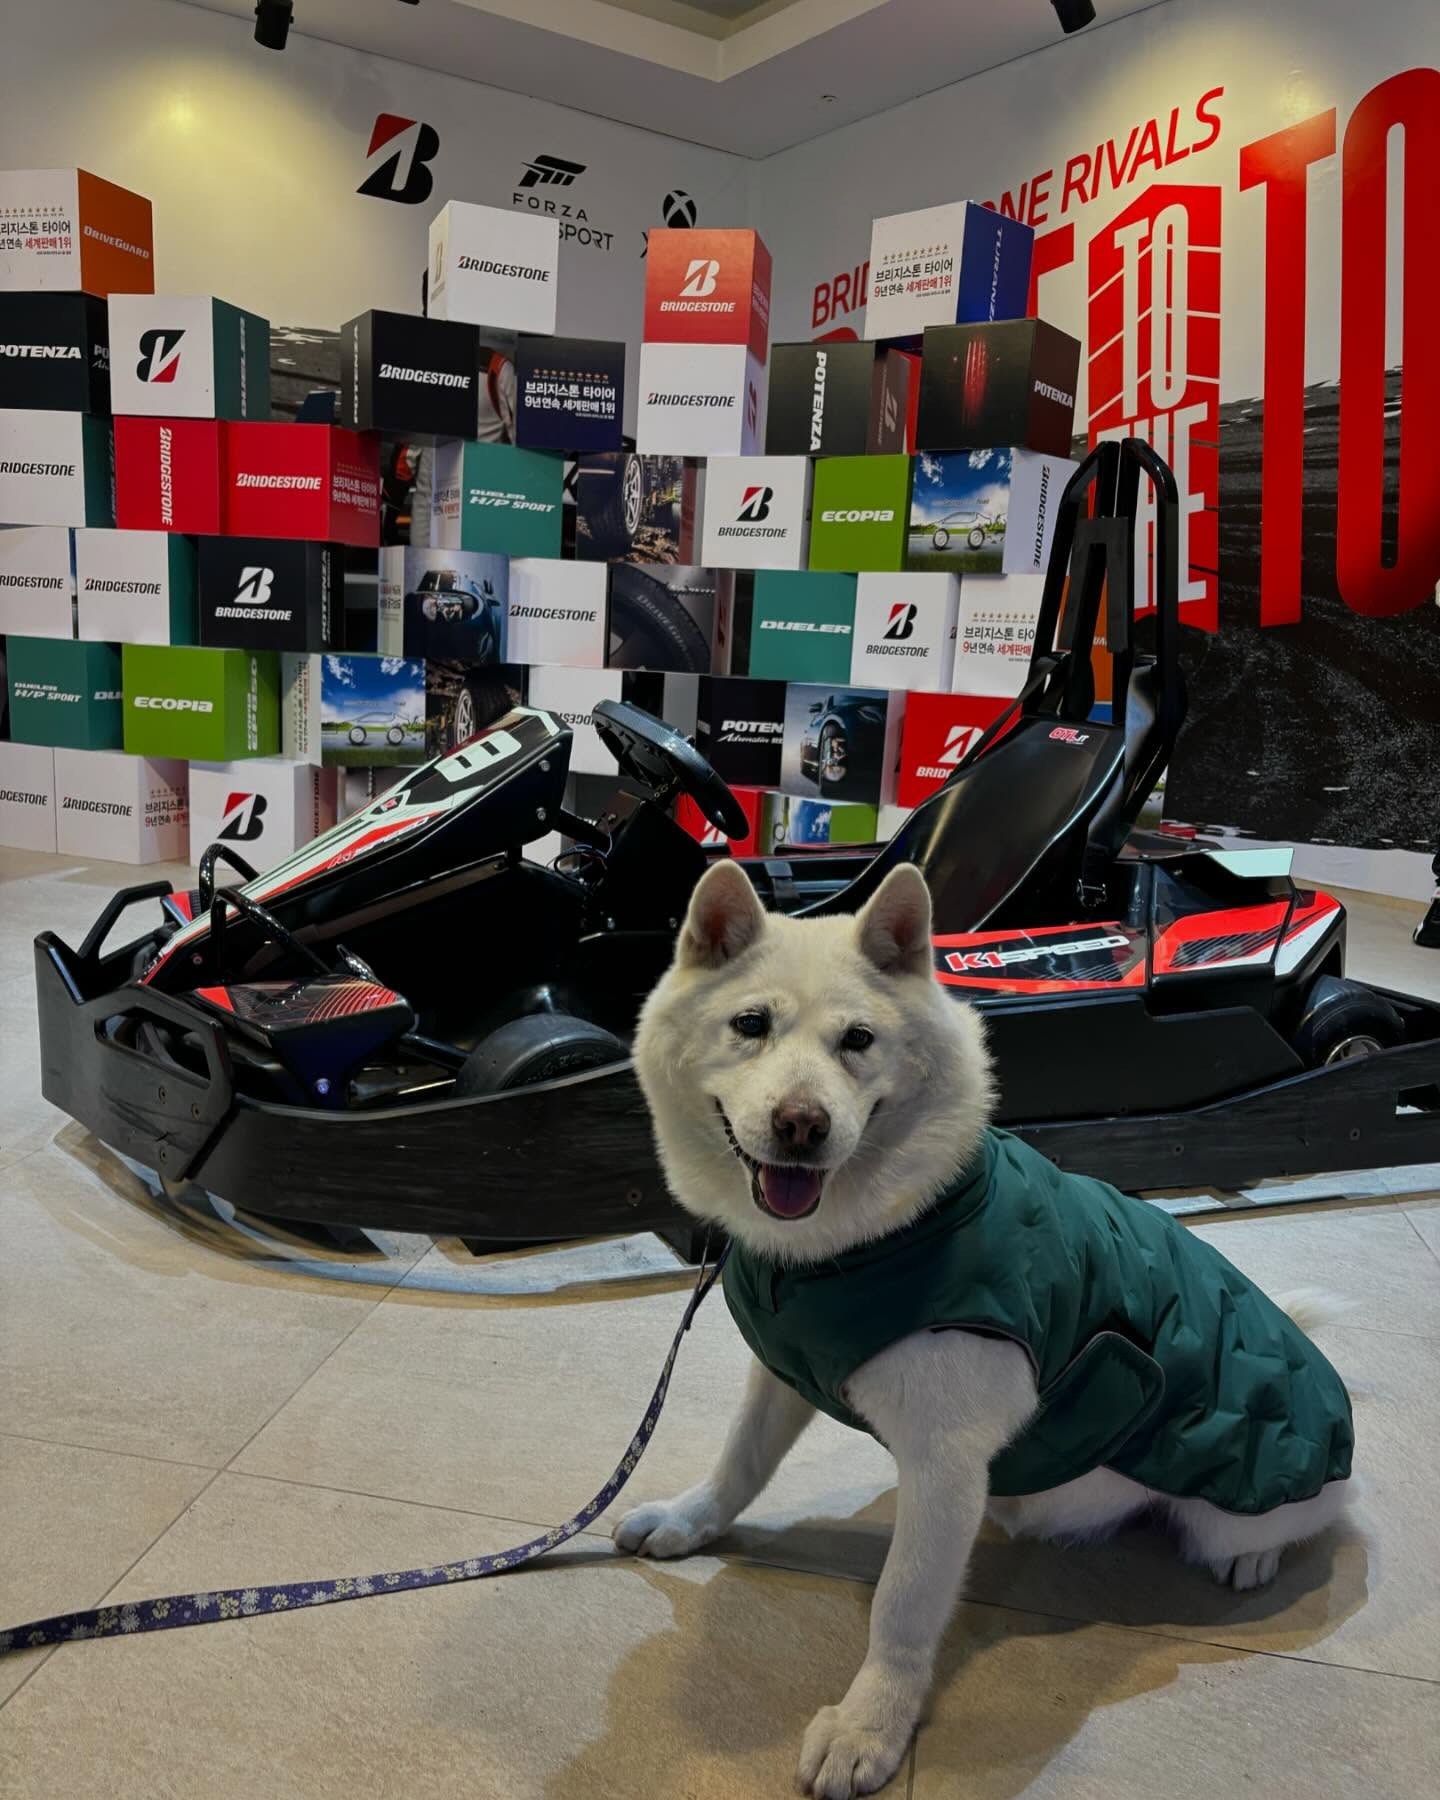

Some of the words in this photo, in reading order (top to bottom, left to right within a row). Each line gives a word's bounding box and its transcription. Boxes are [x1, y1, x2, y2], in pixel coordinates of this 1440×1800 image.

[1061, 87, 1224, 213] RIVALS
[513, 193, 588, 221] FORZA
[0, 221, 39, 236] 리지스톤
[42, 220, 70, 235] 타이어
[458, 256, 550, 282] BRIDGESTONE
[875, 263, 921, 283] 브리지스톤
[924, 257, 953, 275] 타이어
[660, 301, 736, 313] BRIDGESTONE
[1114, 203, 1188, 419] TO
[379, 363, 471, 389] BRIDGESTONE
[525, 381, 580, 398] 브리지스톤
[583, 385, 615, 401] 타이어
[647, 392, 736, 407] BRIDGESTONE
[1033, 380, 1073, 408] POTENZA
[810, 351, 827, 451] POTENZA
[160, 426, 173, 526] BRIDGESTONE
[236, 472, 322, 490] BRIDGESTONE
[470, 496, 510, 507] H/P
[511, 499, 556, 512] SPORT
[1033, 464, 1050, 569] BRIDGESTONE
[718, 527, 788, 538] BRIDGESTONE
[84, 578, 162, 595] BRIDGESTONE
[214, 606, 292, 620] BRIDGESTONE
[509, 605, 597, 622] BRIDGESTONE
[760, 620, 852, 634] DUELER
[964, 626, 1014, 641] 브리지스톤
[866, 644, 930, 658] BRIDGESTONE
[15, 689, 46, 699] H/P
[47, 692, 82, 703] SPORT
[63, 796, 134, 817] BRIDGESTONE
